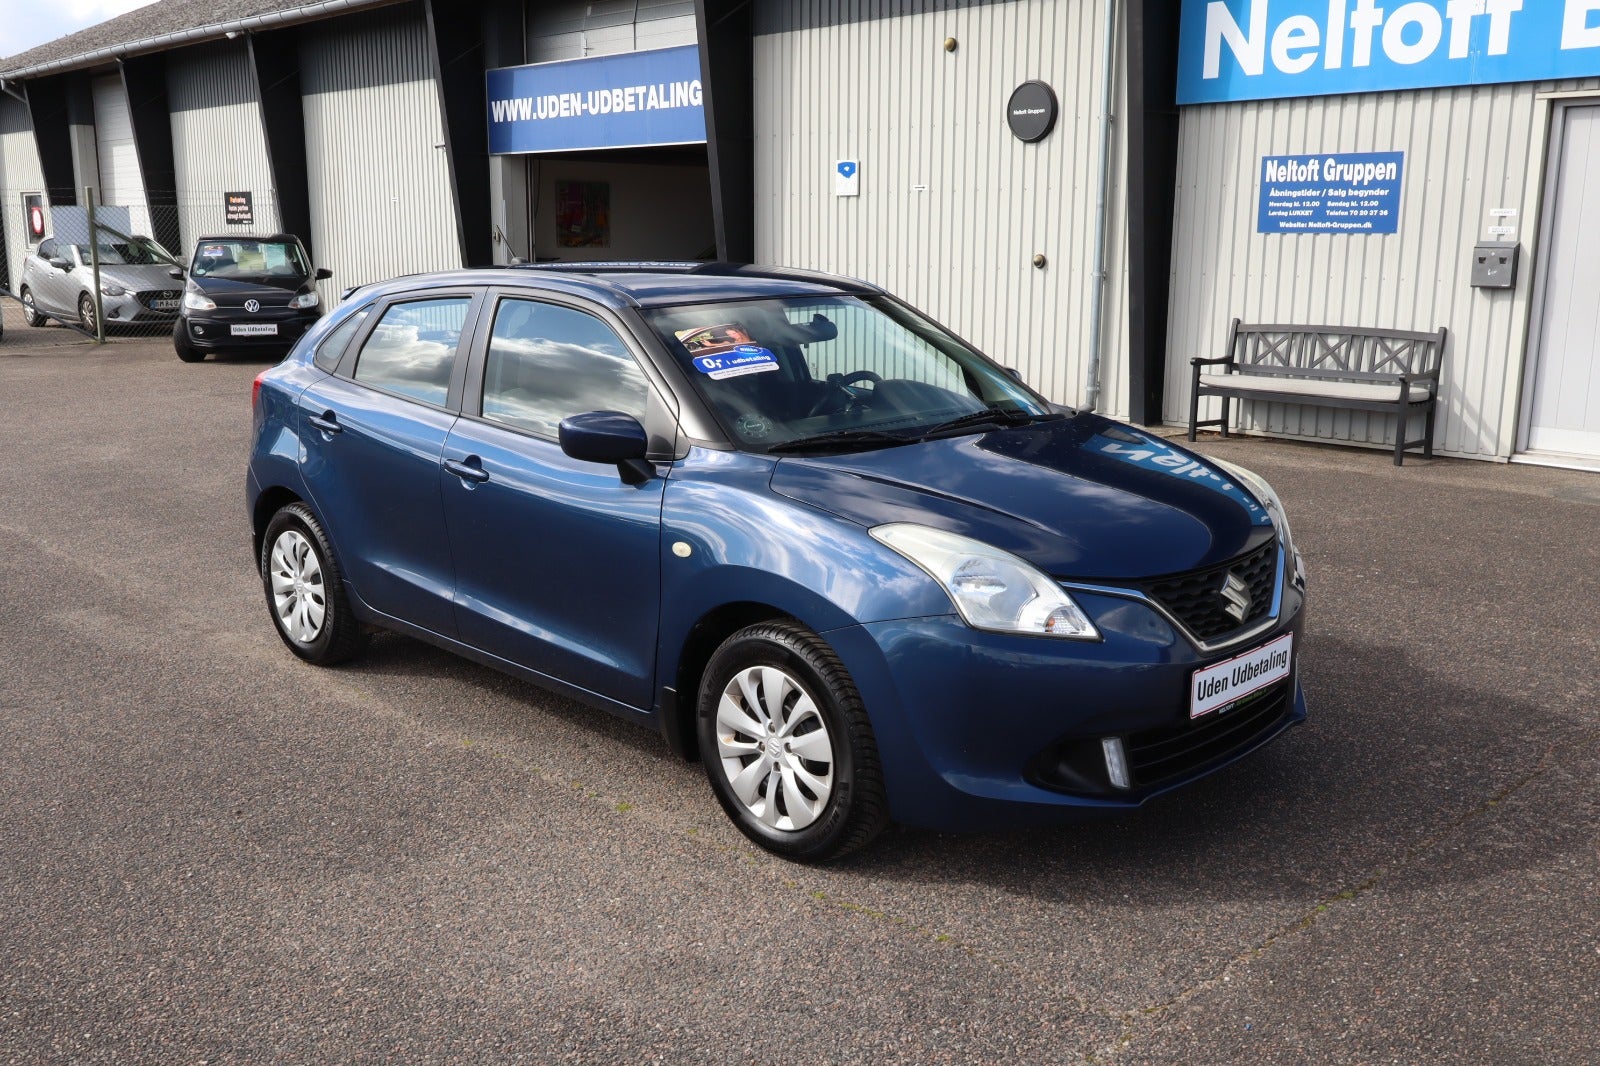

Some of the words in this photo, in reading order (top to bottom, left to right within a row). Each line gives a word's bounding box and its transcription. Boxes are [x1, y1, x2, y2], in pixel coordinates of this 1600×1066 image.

[1202, 0, 1523, 80] Neltoft
[491, 79, 703, 123] WWW.UDEN-UDBETALING
[1265, 158, 1320, 183] Neltoft
[1323, 158, 1397, 186] Gruppen
[1269, 188, 1321, 197] Åbningstider
[1327, 188, 1347, 198] Salg
[1348, 188, 1390, 197] begynder
[731, 355, 771, 364] udbetaling
[1197, 676, 1228, 701] Uden
[1231, 649, 1288, 687] Udbetaling
